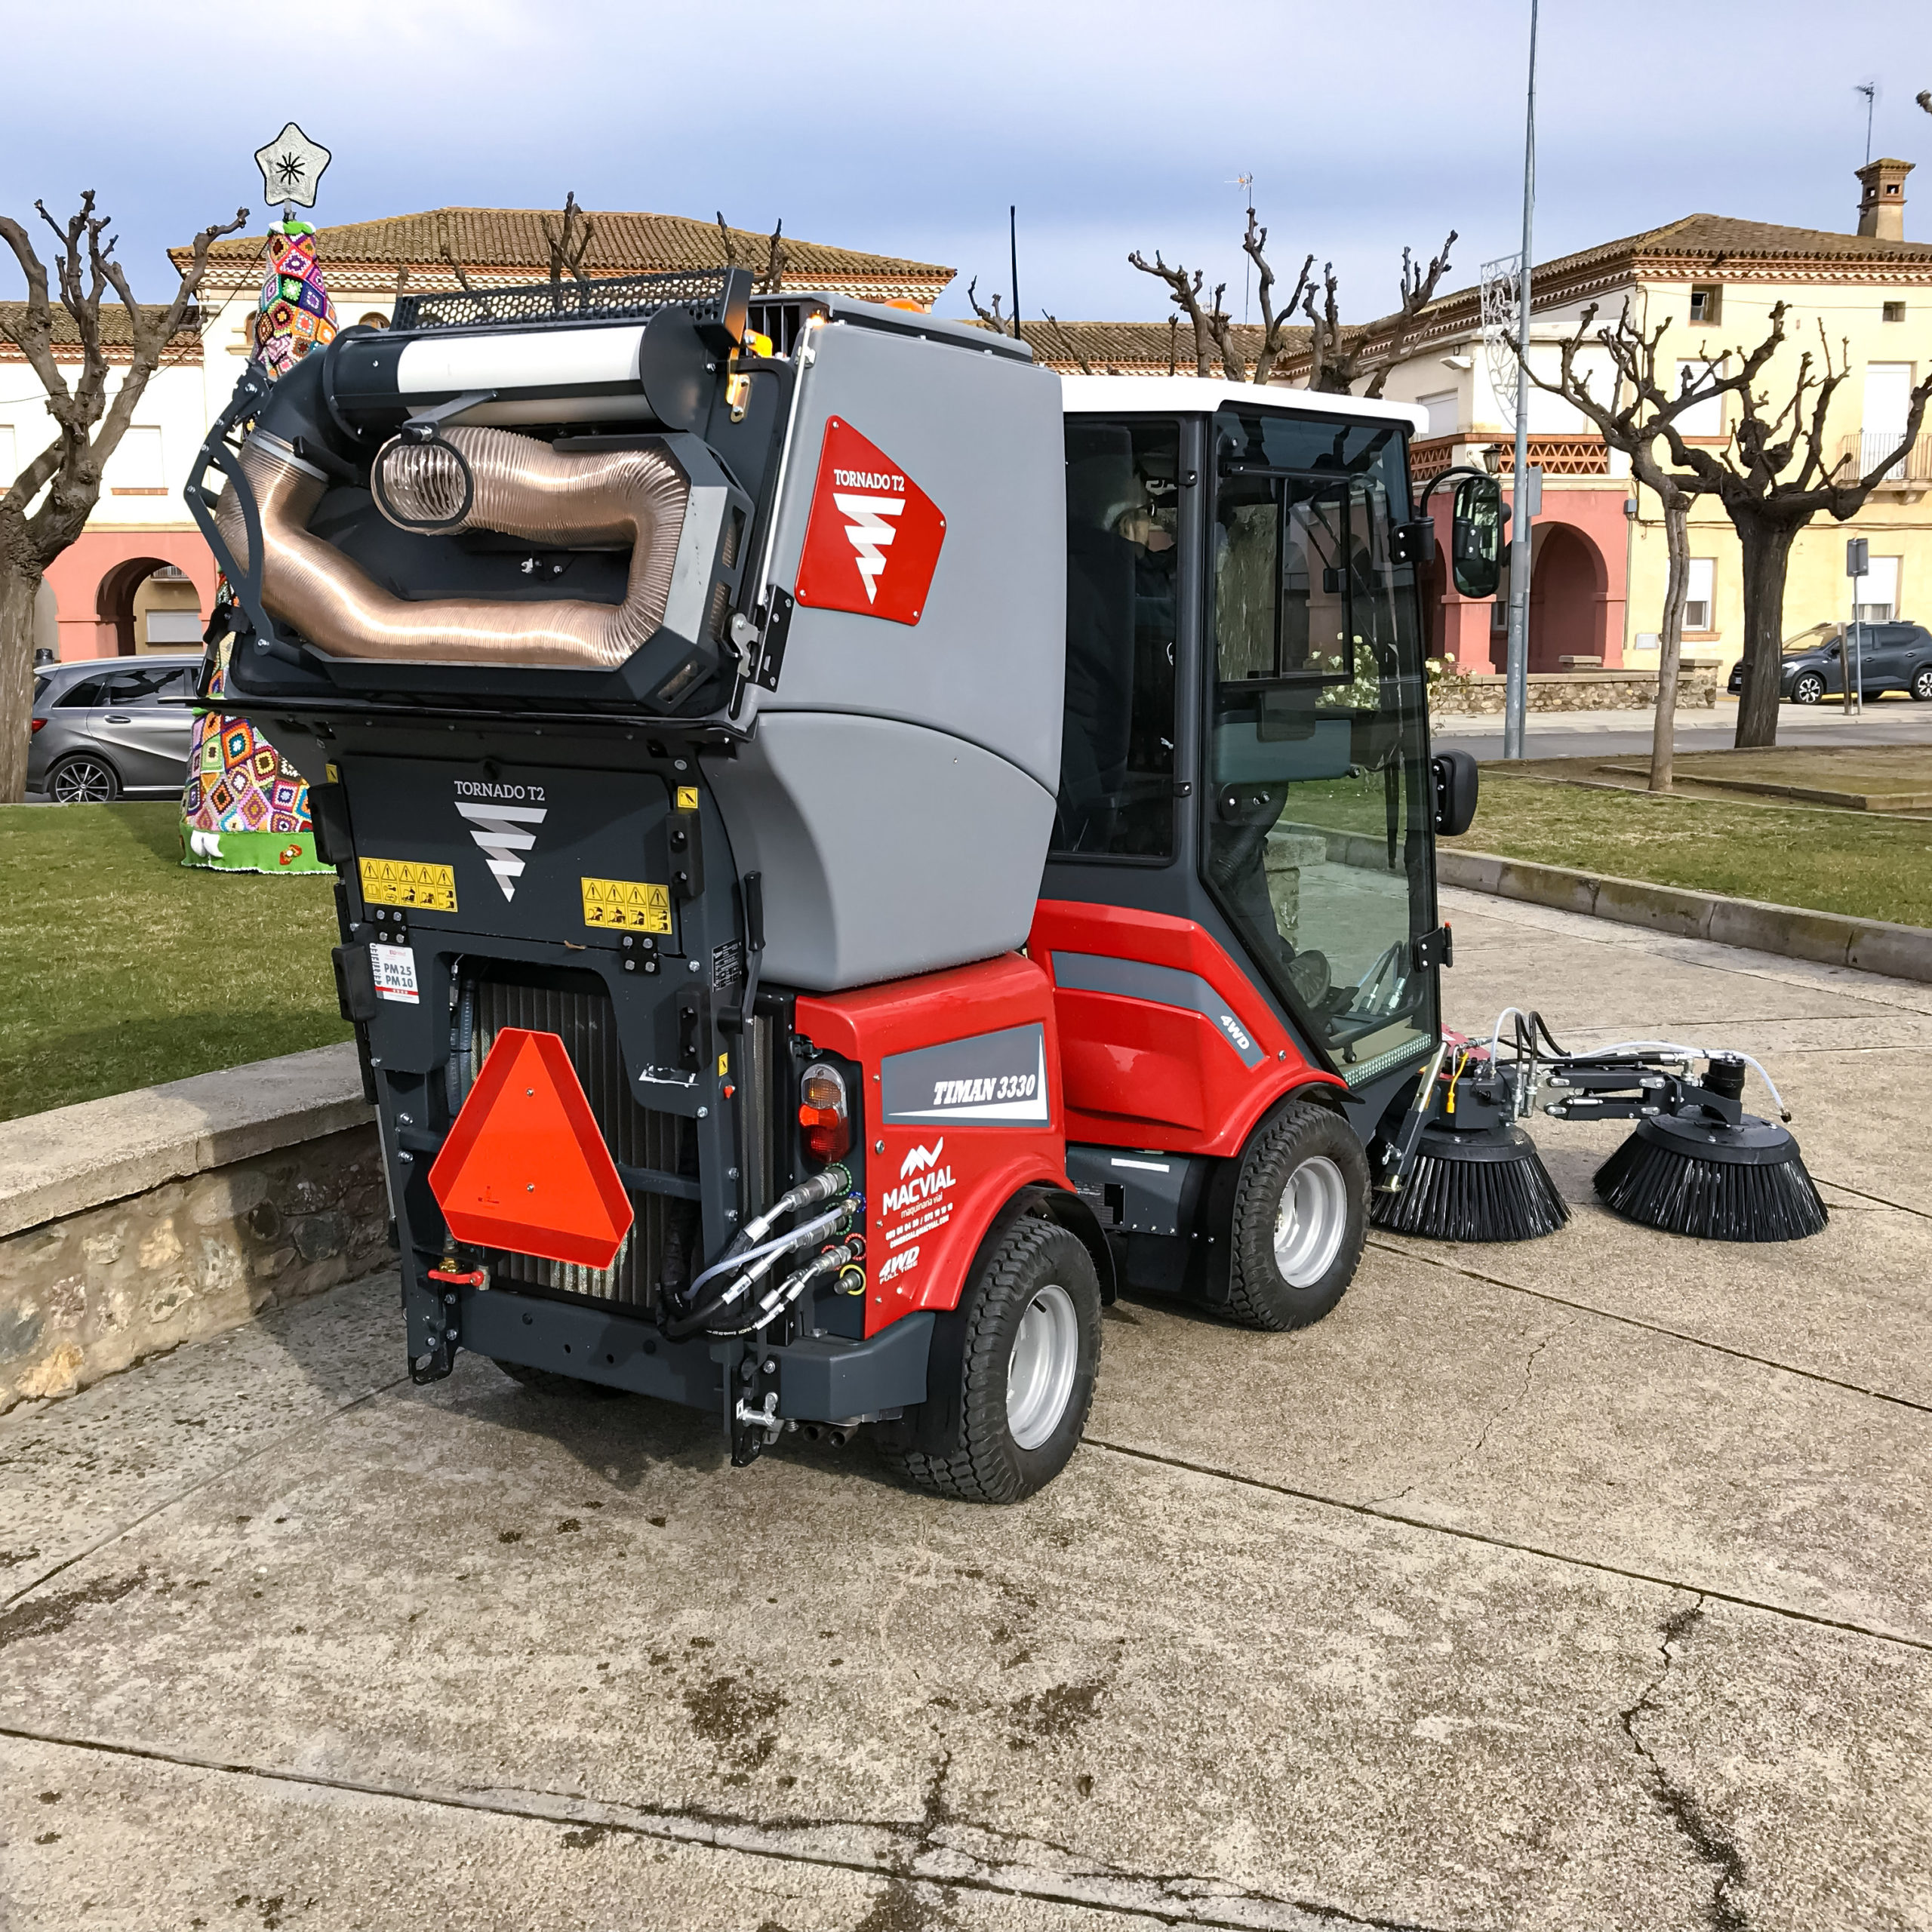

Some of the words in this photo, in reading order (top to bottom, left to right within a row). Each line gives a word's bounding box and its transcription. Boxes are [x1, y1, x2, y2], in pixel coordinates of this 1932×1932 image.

[834, 469, 890, 490] TORNADO
[892, 475, 905, 491] T2
[454, 780, 525, 799] TORNADO
[528, 786, 545, 801] T2
[383, 963, 399, 974] PM
[386, 975, 401, 986] PM
[402, 977, 414, 988] 10
[1220, 1015, 1250, 1050] 4WD
[933, 1078, 997, 1105] TIMAN
[998, 1074, 1036, 1100] 3330
[882, 1165, 957, 1216] MACVIAL
[878, 1246, 920, 1278] 4WD
[879, 1271, 899, 1285] FULL
[900, 1260, 918, 1273] TIME
